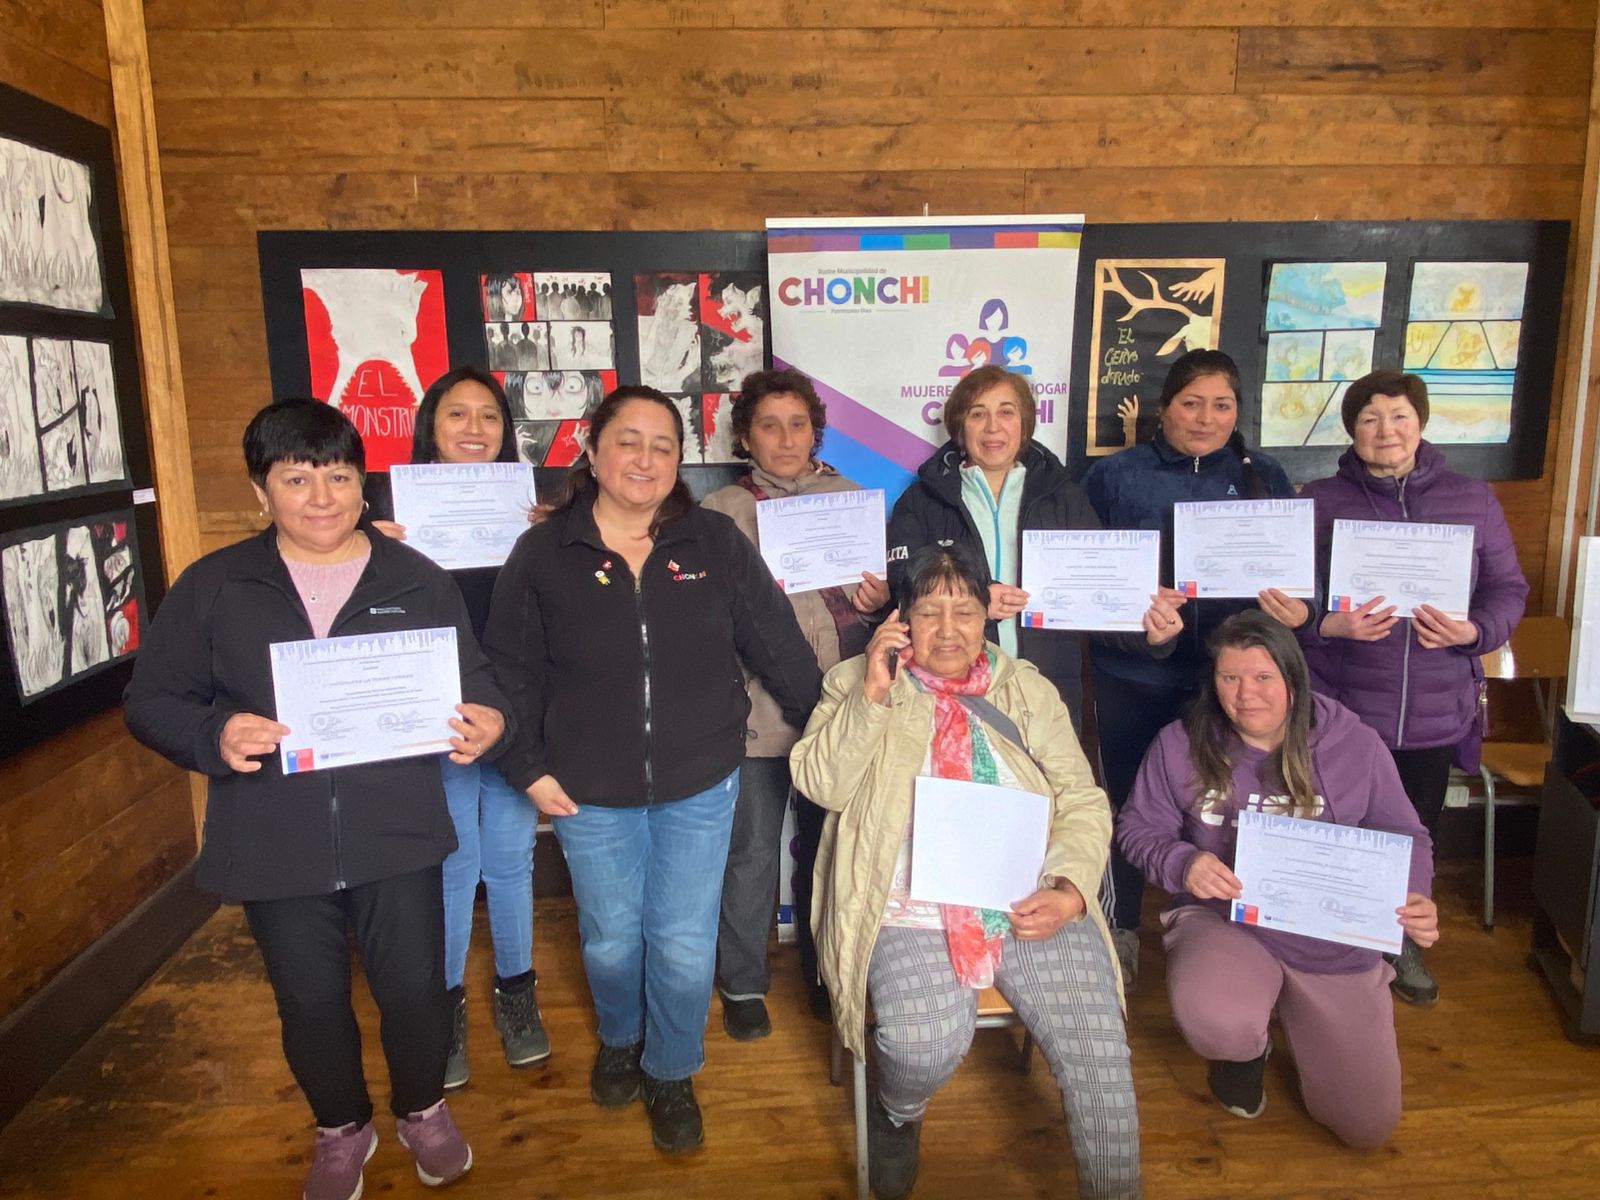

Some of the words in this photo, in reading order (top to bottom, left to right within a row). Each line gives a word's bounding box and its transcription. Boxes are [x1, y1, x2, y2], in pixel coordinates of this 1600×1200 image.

[778, 275, 929, 306] CHONCHI
[1118, 327, 1135, 344] EL
[358, 370, 399, 397] EL
[900, 385, 953, 398] MUJERE
[342, 404, 416, 438] MONSTRU
[887, 545, 909, 561] LITA
